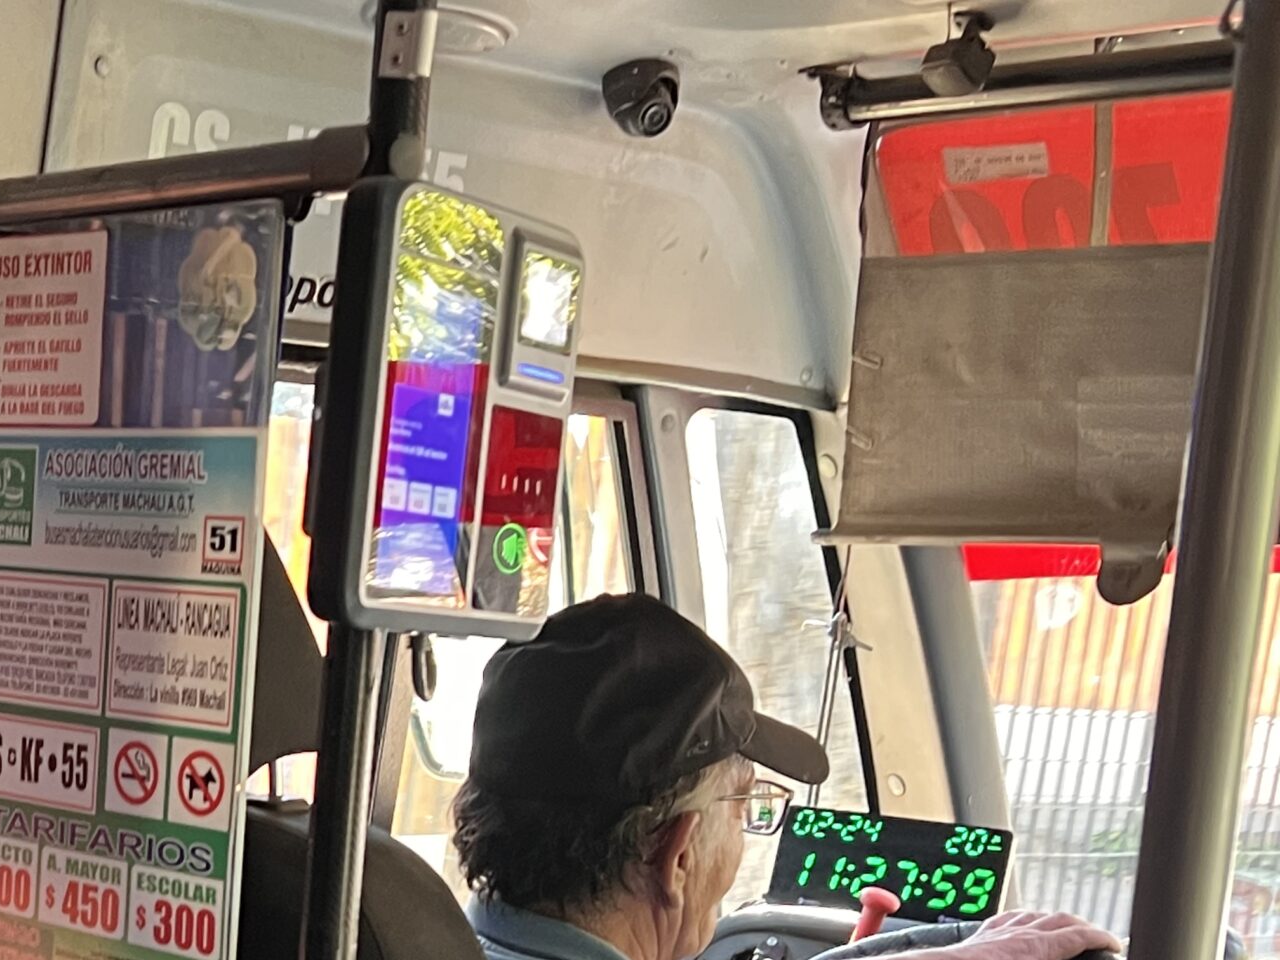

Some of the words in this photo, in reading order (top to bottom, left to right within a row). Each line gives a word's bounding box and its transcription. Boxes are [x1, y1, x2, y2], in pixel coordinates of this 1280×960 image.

[24, 251, 92, 278] EXTINTOR
[35, 294, 43, 308] EL
[53, 311, 61, 325] EL
[64, 309, 88, 325] SELLO
[38, 340, 46, 354] EL
[28, 384, 38, 397] LA
[1, 402, 6, 415] A
[8, 402, 17, 415] LA
[45, 444, 132, 480] ASOCIACIÓN
[137, 451, 205, 480] GREMIAL
[59, 491, 120, 511] TRANSPORTE
[210, 526, 238, 553] 51
[184, 601, 231, 638] RANCAGUA
[792, 809, 883, 843] 02-24
[65, 859, 121, 885] MAYOR
[798, 852, 996, 914] 11:27:59
[137, 872, 216, 905] ESCOLAR
[61, 880, 119, 933] 450
[153, 899, 216, 956] 300
